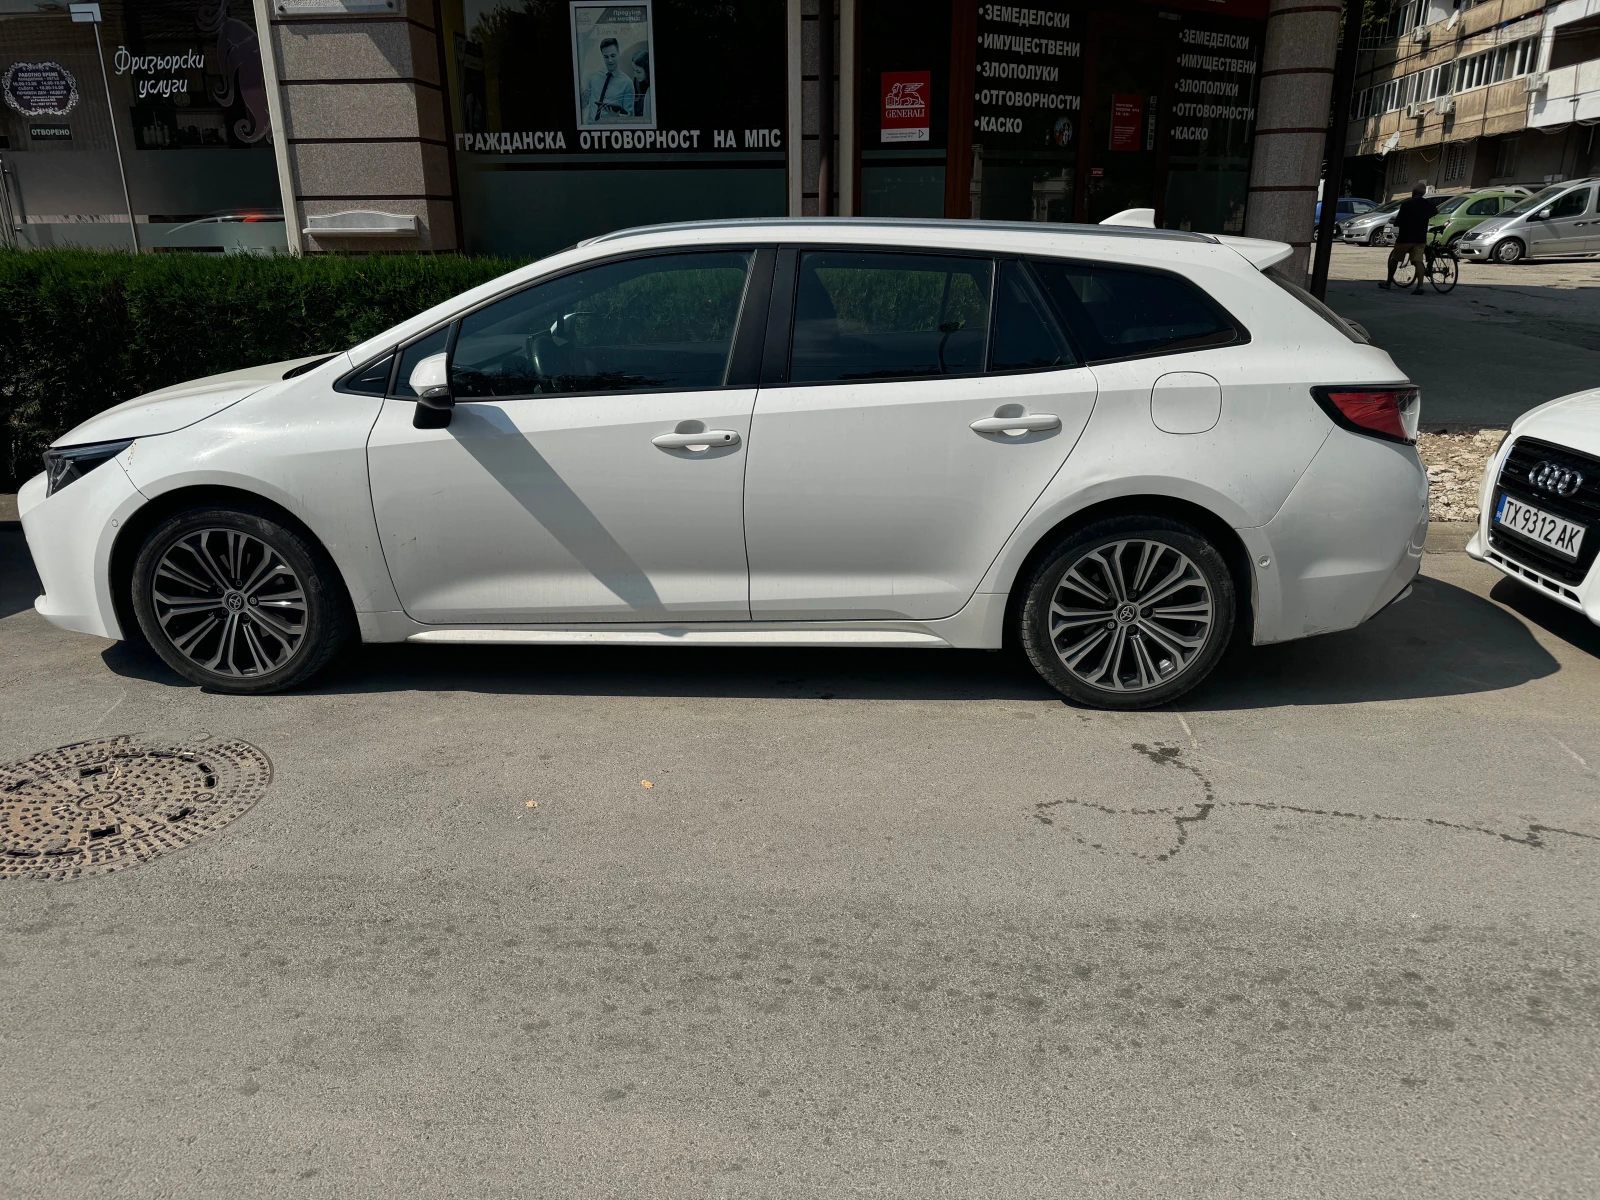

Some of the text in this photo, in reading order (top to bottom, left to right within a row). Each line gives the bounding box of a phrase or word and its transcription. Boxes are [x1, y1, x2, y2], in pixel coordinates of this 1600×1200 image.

[985, 4, 1070, 28] ЗЕМЕДЕЛСКИ
[983, 33, 1080, 57] ИМУЩЕСТВЕНИ
[1183, 29, 1250, 50] ЗЕМЕДЕЛСКИ
[114, 45, 204, 74] Фризьорски
[1181, 54, 1256, 74] ИМУЩЕСТВЕНИ
[982, 61, 1059, 82] ЗЛОПОЛУКИ
[138, 78, 188, 98] услуги
[1179, 79, 1239, 97] ЗЛОПОЛУКИ
[980, 89, 1080, 110] ОТГОВОРНОСТИ
[885, 109, 925, 118] GENERALI
[1177, 102, 1255, 121] ОТГОВОРНОСТИ
[980, 116, 1023, 134] КАСКО
[1175, 125, 1209, 141] КАСКО
[455, 129, 782, 153] ГРАЖДАНСКА ОТГОВОРНОСТ НА МПС
[1503, 501, 1581, 553] TX 9312 AK
